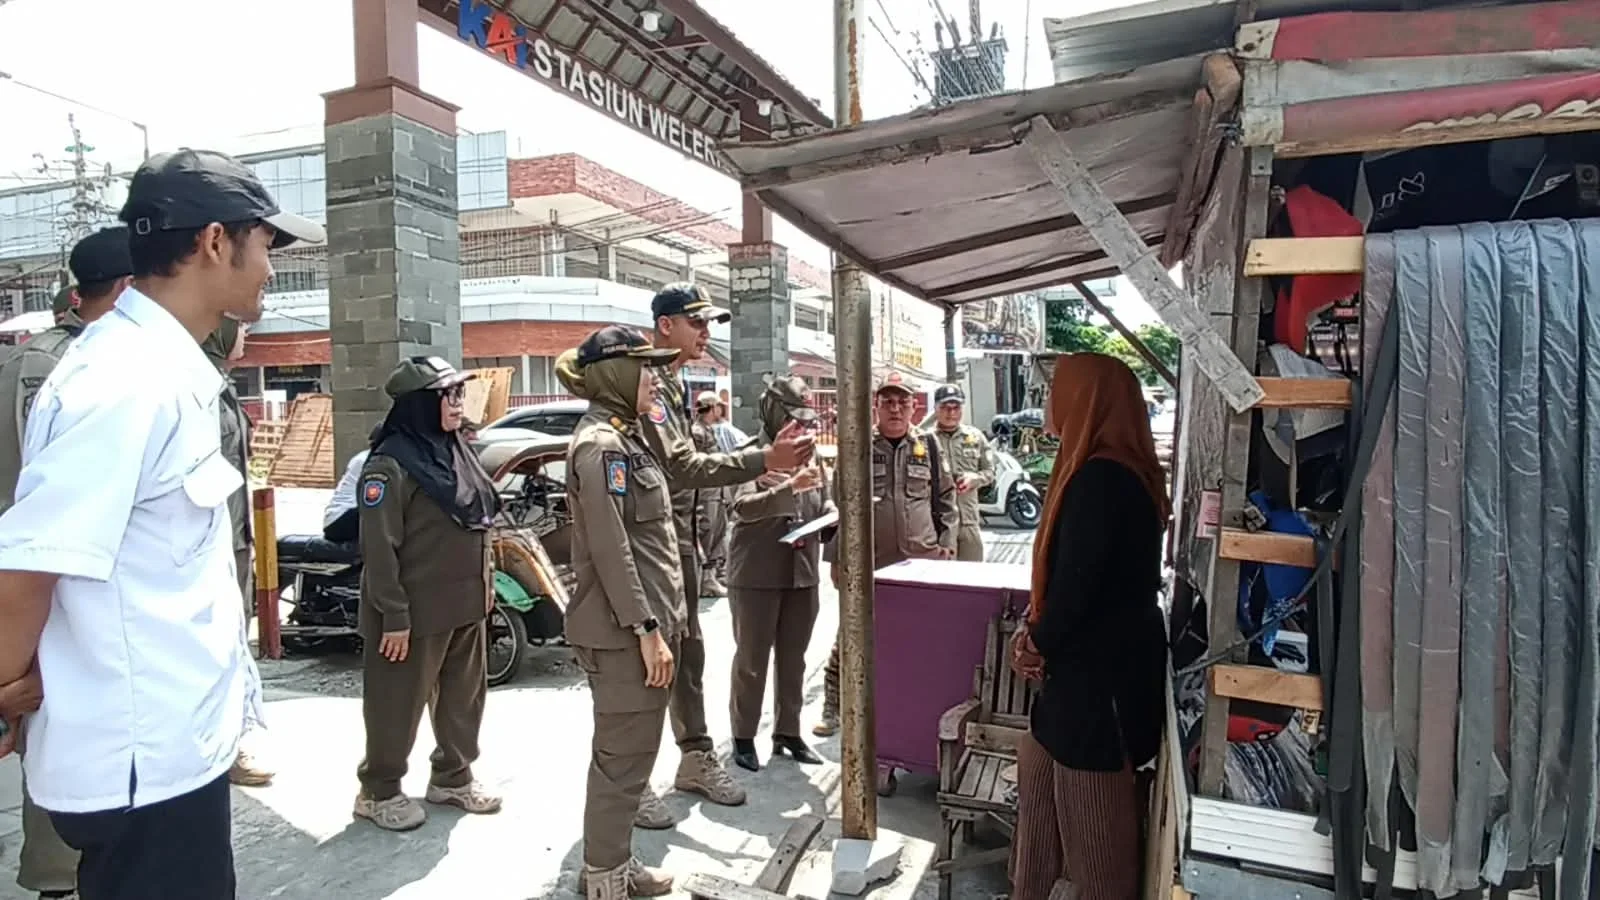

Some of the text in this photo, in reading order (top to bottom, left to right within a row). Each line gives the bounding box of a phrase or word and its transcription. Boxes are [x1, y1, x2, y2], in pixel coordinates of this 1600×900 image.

[457, 0, 720, 168] KAI STASIUN WELER
